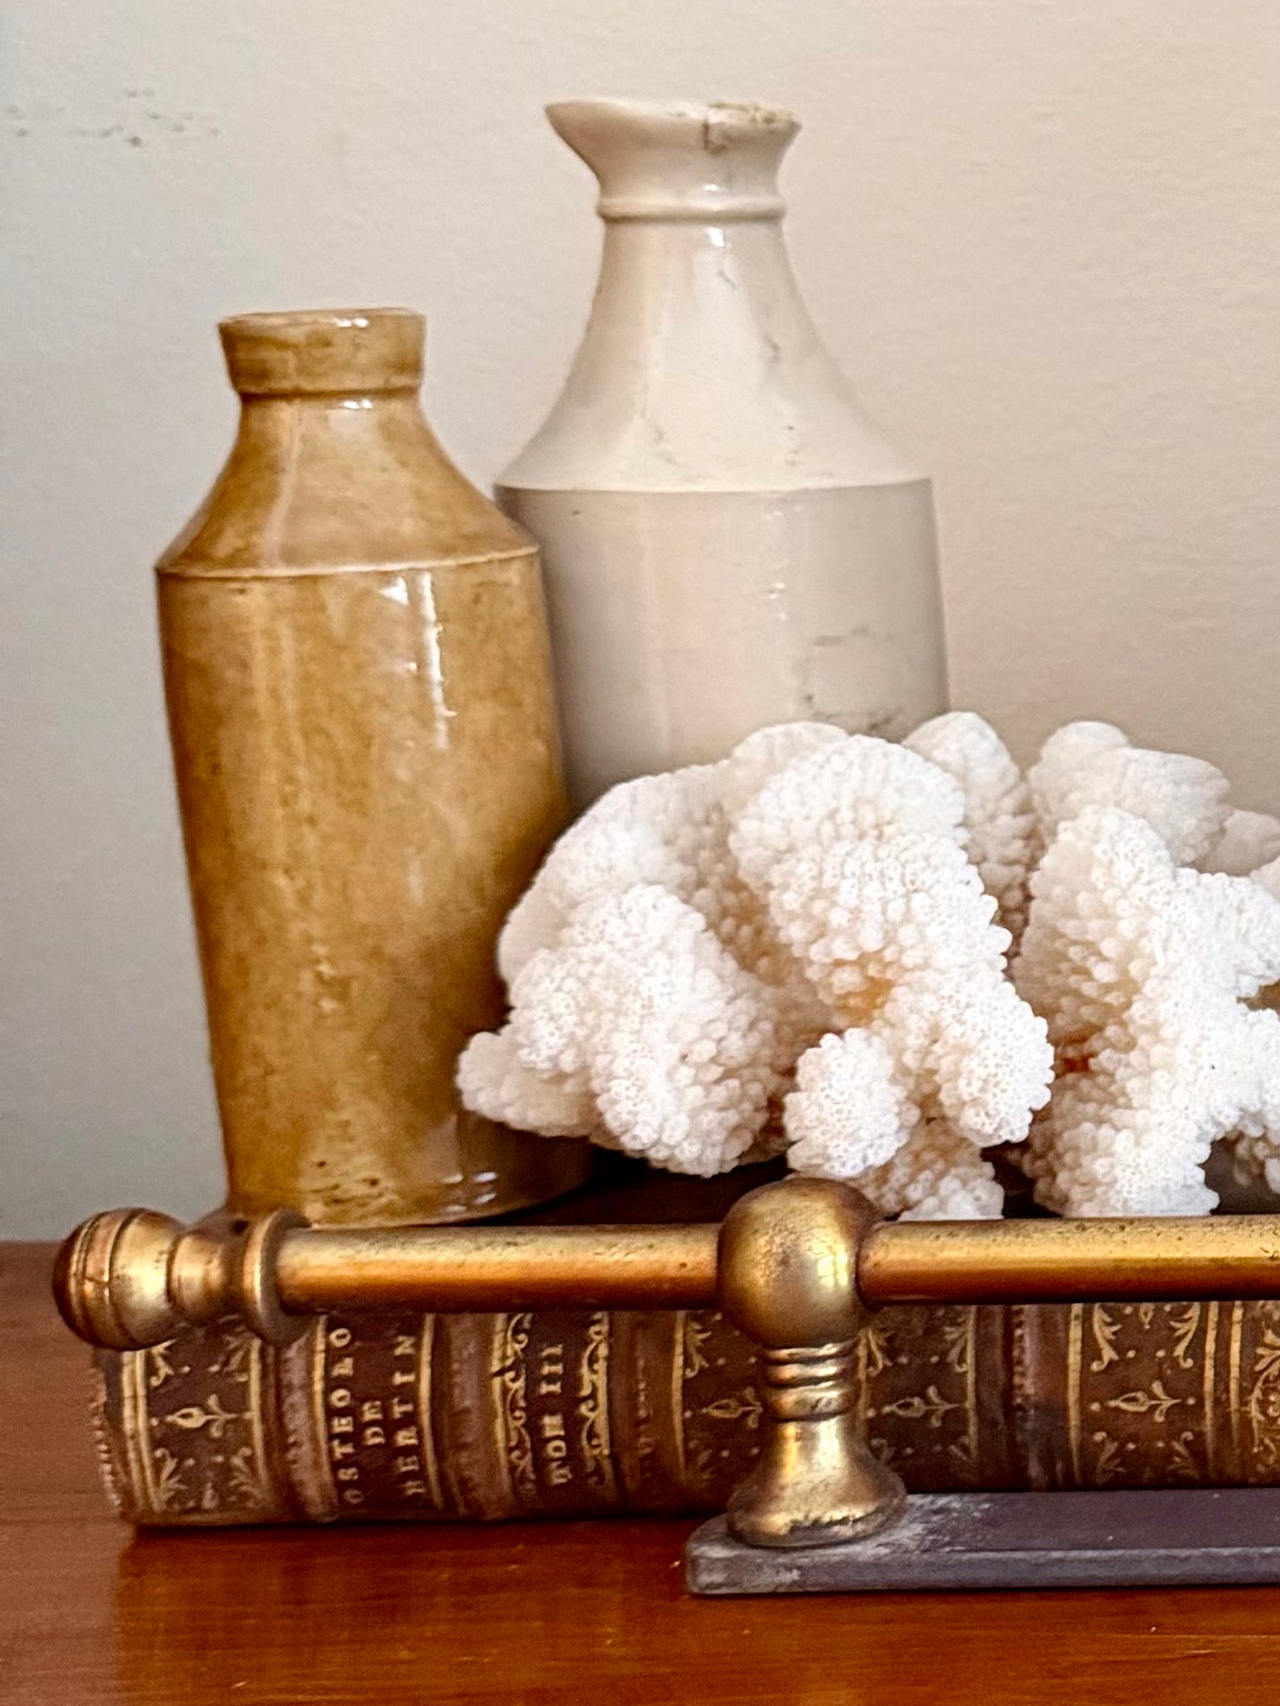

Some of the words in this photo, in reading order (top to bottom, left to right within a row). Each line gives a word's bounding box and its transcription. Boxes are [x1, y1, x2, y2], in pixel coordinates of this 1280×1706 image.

[540, 1344, 564, 1395] III
[361, 1400, 386, 1446] DE
[543, 1413, 573, 1486] TOM
